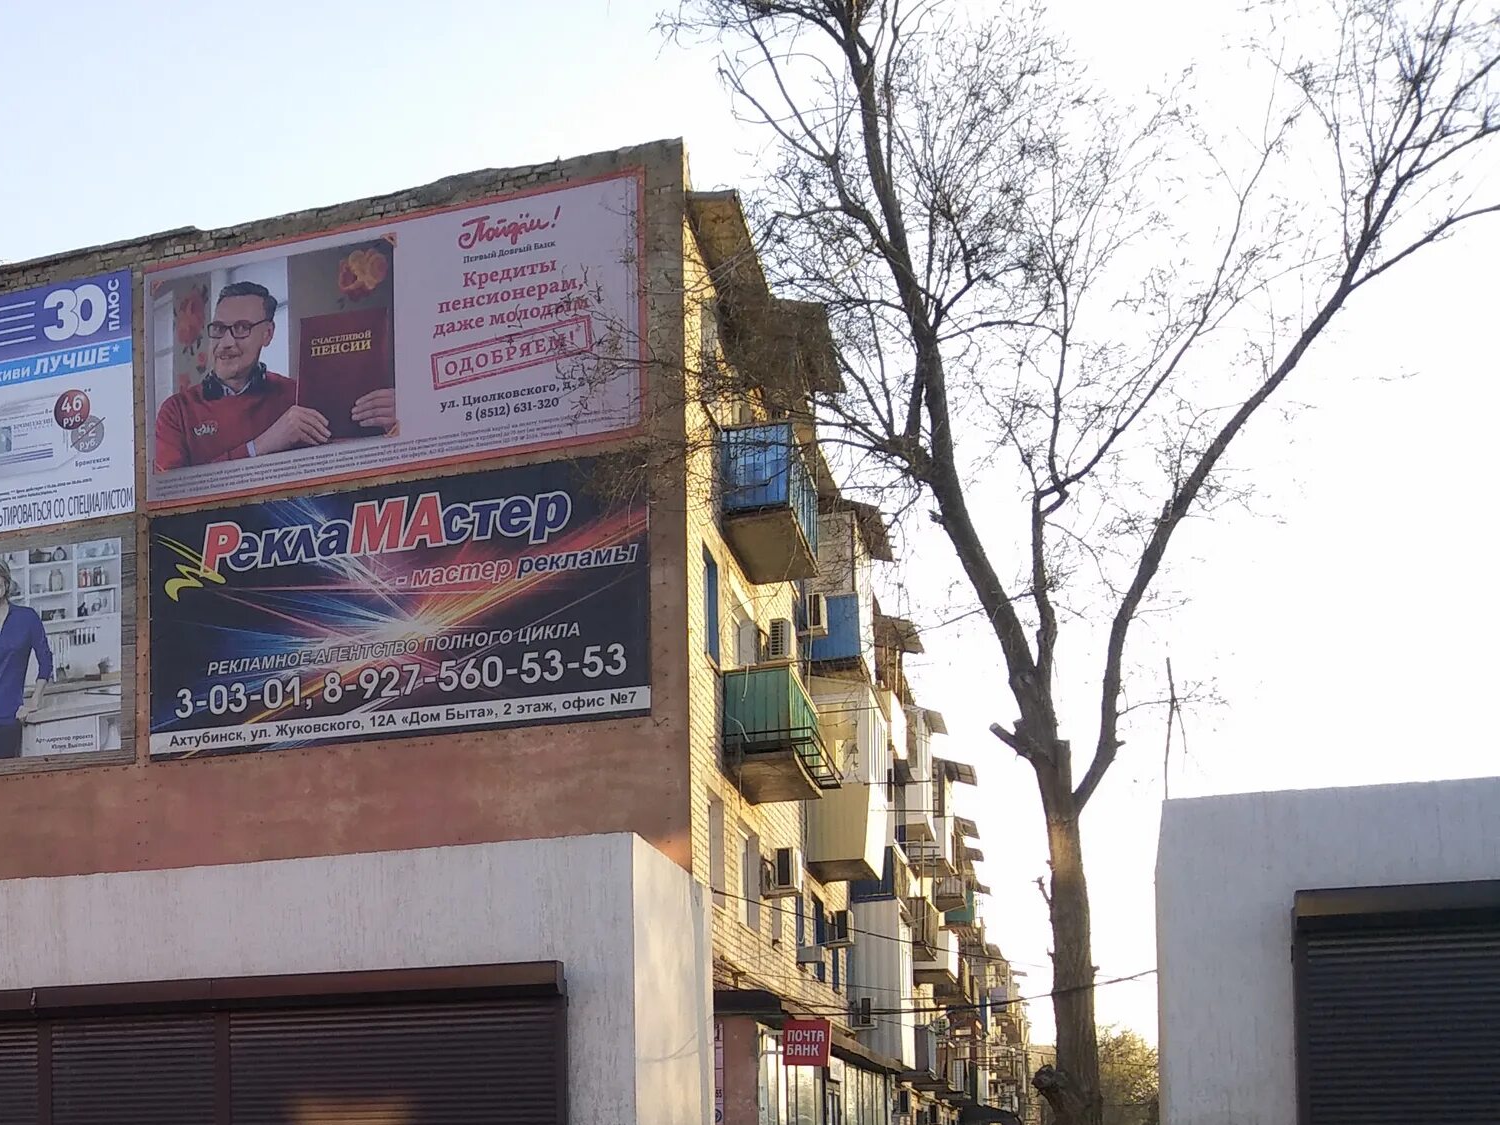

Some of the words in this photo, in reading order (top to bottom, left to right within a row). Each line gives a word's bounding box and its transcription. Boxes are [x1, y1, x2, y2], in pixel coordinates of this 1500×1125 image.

[462, 259, 557, 290] Кредиты
[108, 278, 121, 332] ПЛЮС
[437, 277, 584, 314] пенсионерам,
[43, 283, 108, 342] 30
[432, 315, 486, 339] даже
[311, 329, 372, 346] СЧАСТЛИВОЙ
[311, 339, 372, 357] ПЕНСИИ
[60, 394, 84, 414] 46
[440, 396, 460, 413] ул.
[462, 382, 561, 406] Циолковского,
[465, 410, 473, 422] 8
[475, 403, 511, 423] (8512)
[513, 396, 560, 414] 631-320
[62, 415, 85, 428] руб.
[53, 501, 65, 519] СО
[68, 486, 134, 517] СПЕЦИАЛИСТОМ
[201, 489, 573, 576] РеклаМАстер
[411, 557, 514, 588] мастер
[515, 543, 639, 580] рекламы
[207, 651, 312, 677] РЕКЛАМНОЕ
[315, 638, 419, 663] АГЕНТСТВО
[423, 628, 513, 653] ПОЛНОГО
[517, 621, 582, 646] ЦИКЛА
[174, 675, 314, 719] 3-03-01,
[323, 642, 628, 704] 8-927-560-53-53
[169, 730, 247, 748] Ахтубинск,
[250, 726, 271, 742] ул.
[275, 719, 365, 738] Жуковского,
[369, 714, 397, 728] 12А
[400, 711, 441, 727] «Дом
[445, 703, 499, 721] Быта»,
[503, 703, 512, 716] 2
[516, 699, 557, 715] этаж,
[561, 694, 605, 711] офис
[609, 690, 638, 705] №7
[786, 1043, 820, 1057] БАНК
[787, 1029, 825, 1043] ПОЧТА
